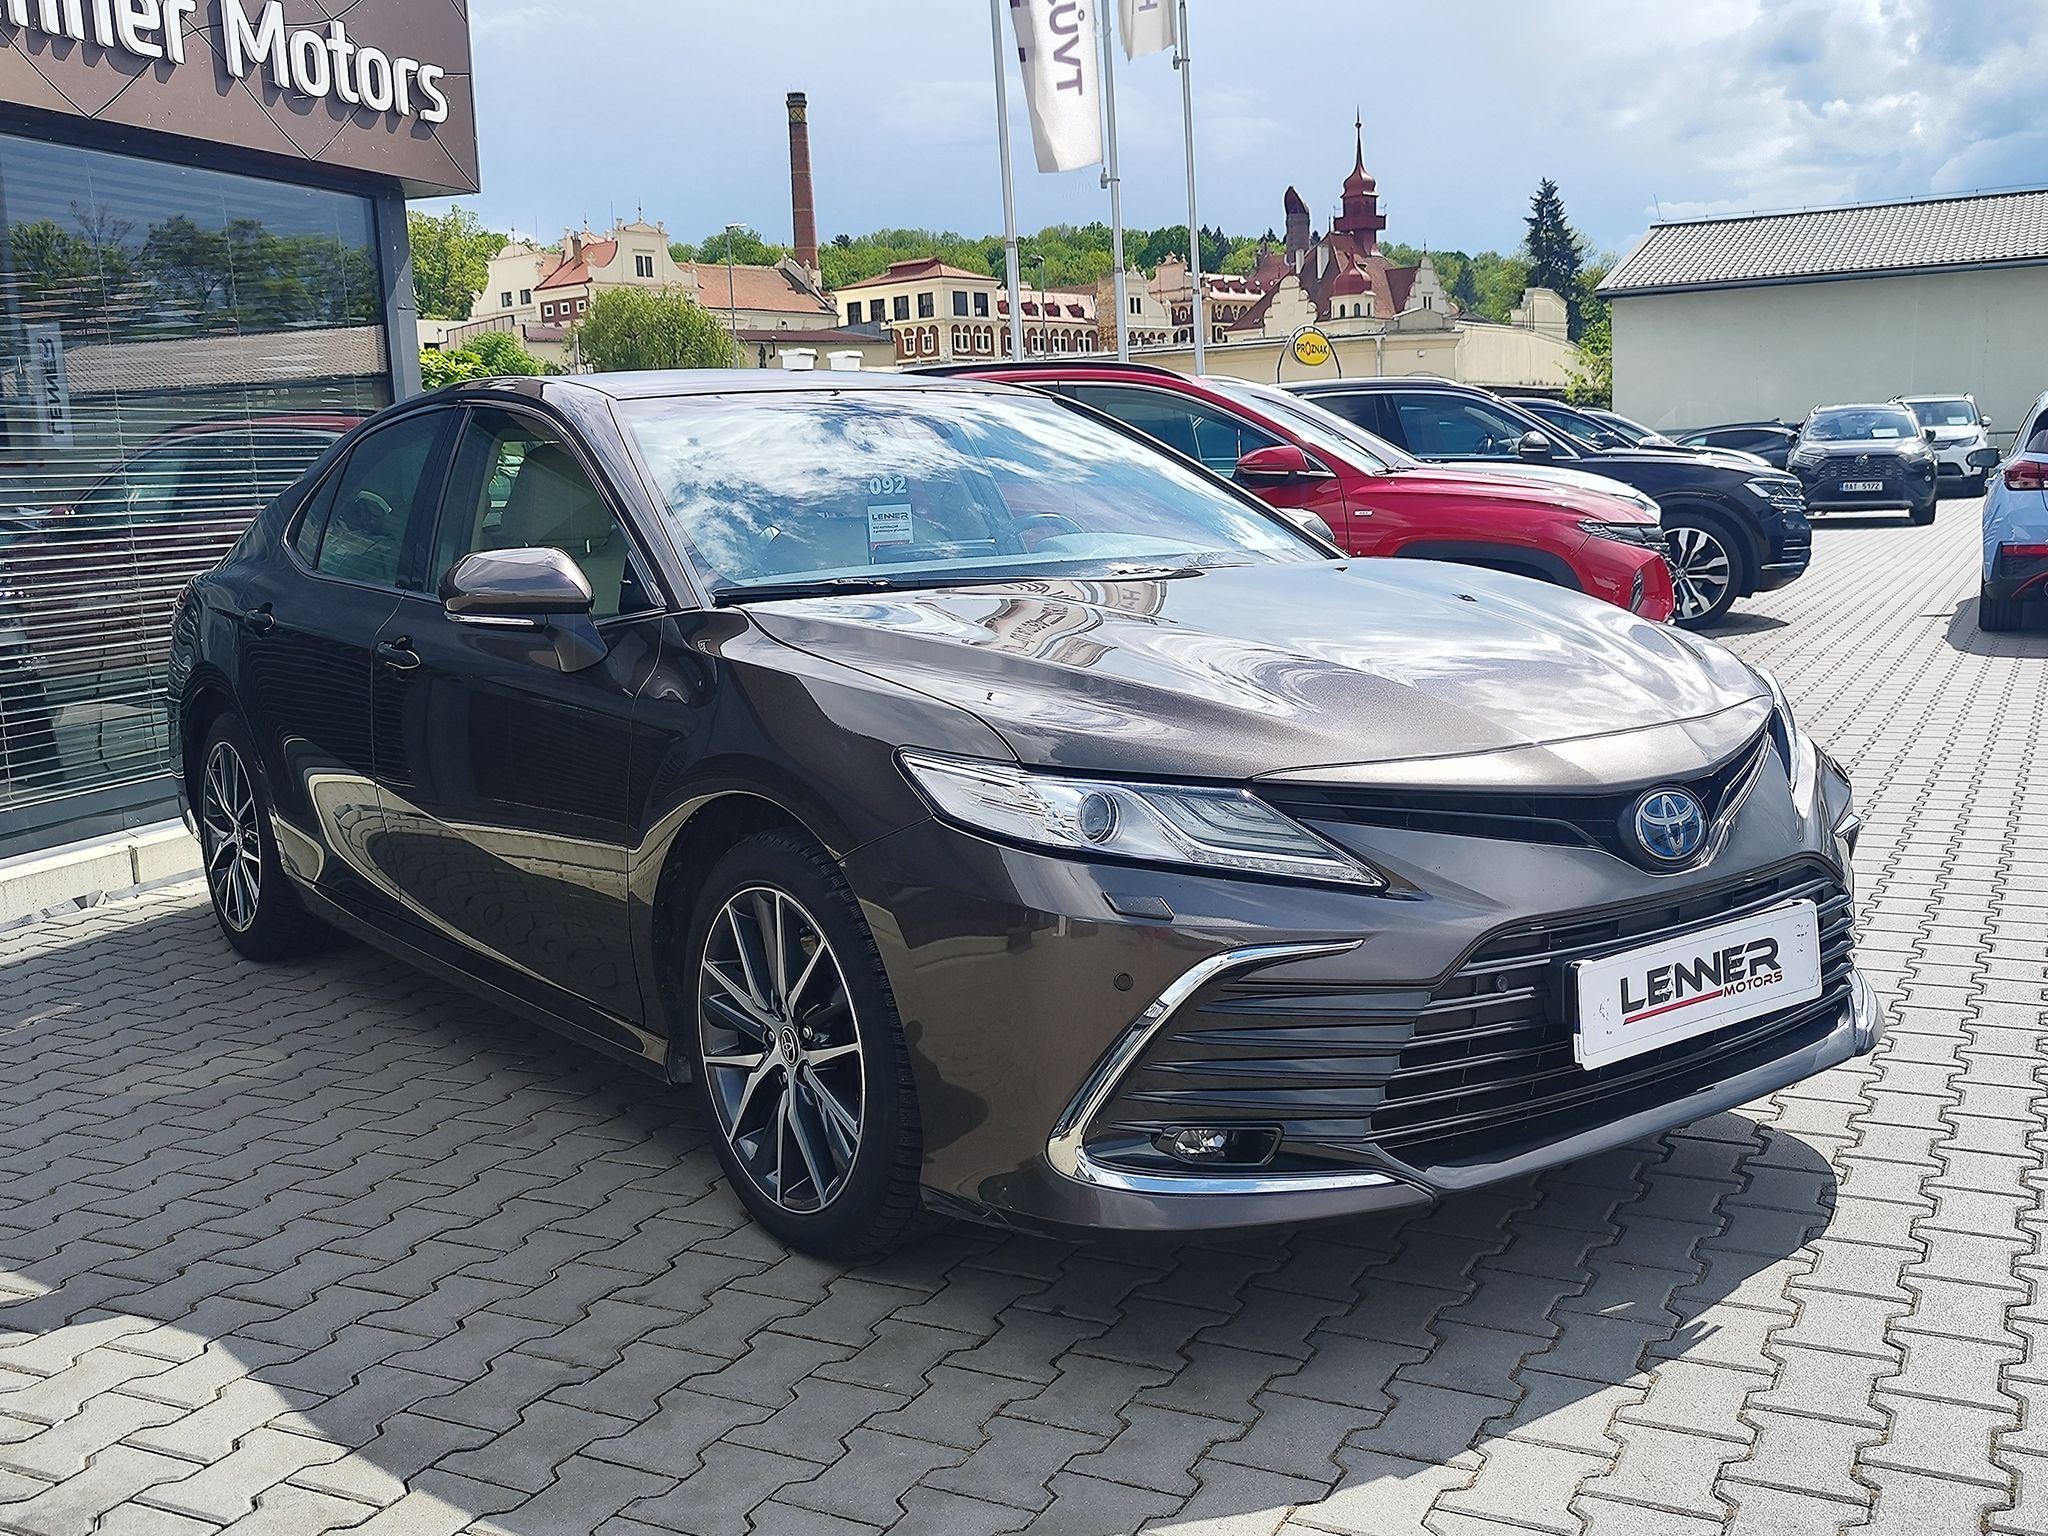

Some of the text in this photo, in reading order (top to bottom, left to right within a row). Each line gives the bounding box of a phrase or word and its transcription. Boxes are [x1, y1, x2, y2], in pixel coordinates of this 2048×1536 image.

[221, 0, 449, 124] Motors
[869, 476, 907, 495] 092
[871, 511, 909, 521] LENNER
[1620, 937, 1782, 1015] LENNER
[1723, 971, 1783, 998] MOTORS
